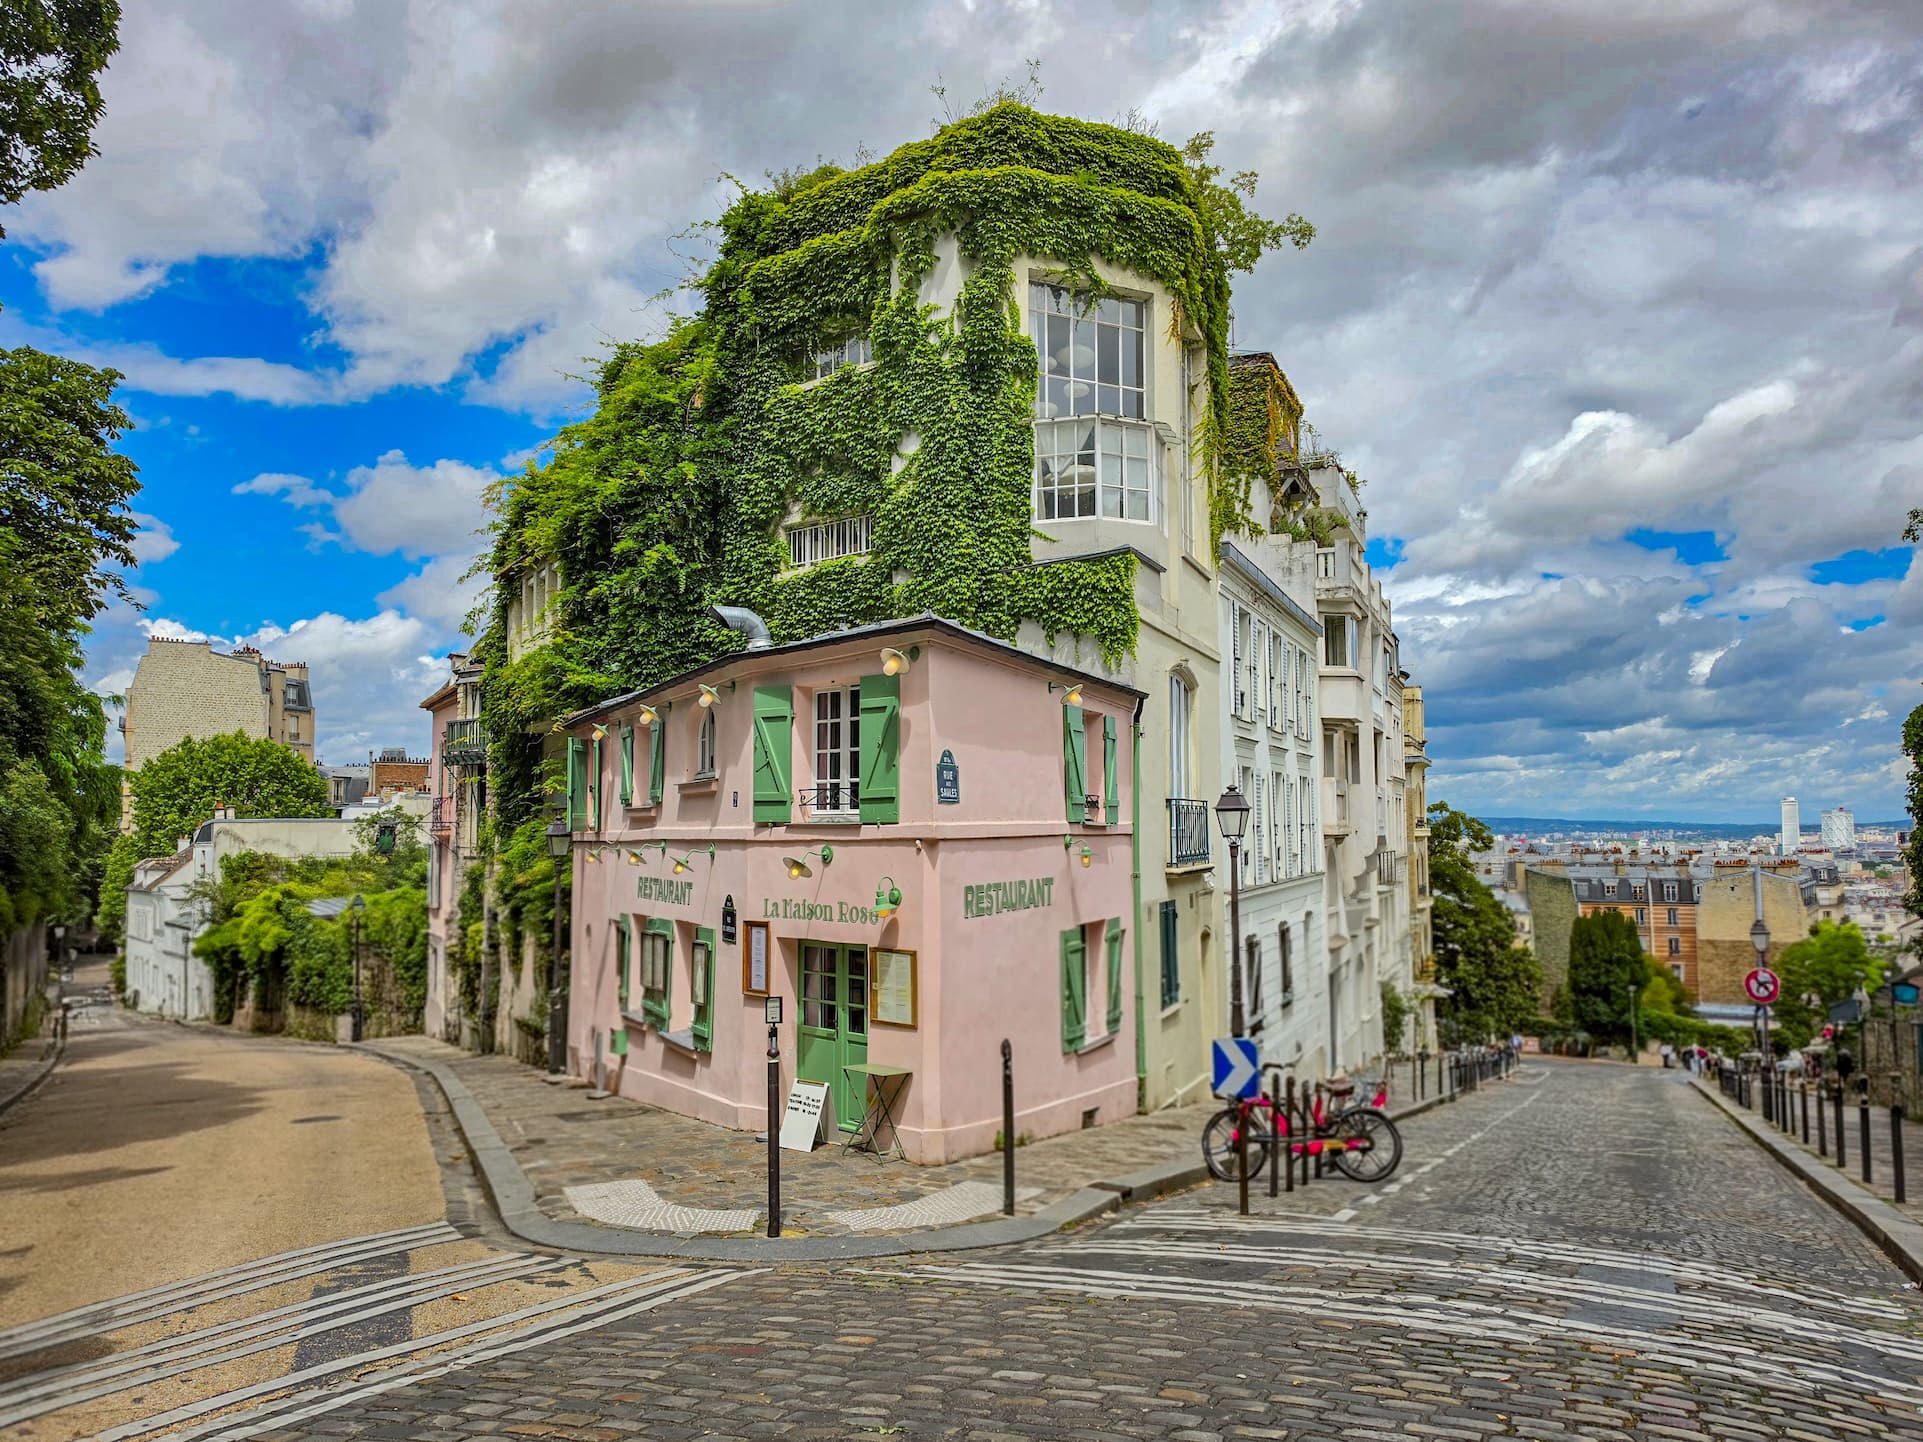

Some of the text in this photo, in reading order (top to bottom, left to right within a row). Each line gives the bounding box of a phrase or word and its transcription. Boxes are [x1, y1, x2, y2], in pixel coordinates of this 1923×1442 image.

[638, 876, 693, 905] RESTAURANT
[964, 877, 1054, 919] RESTAURANT
[763, 898, 879, 925] La Maison Rose
